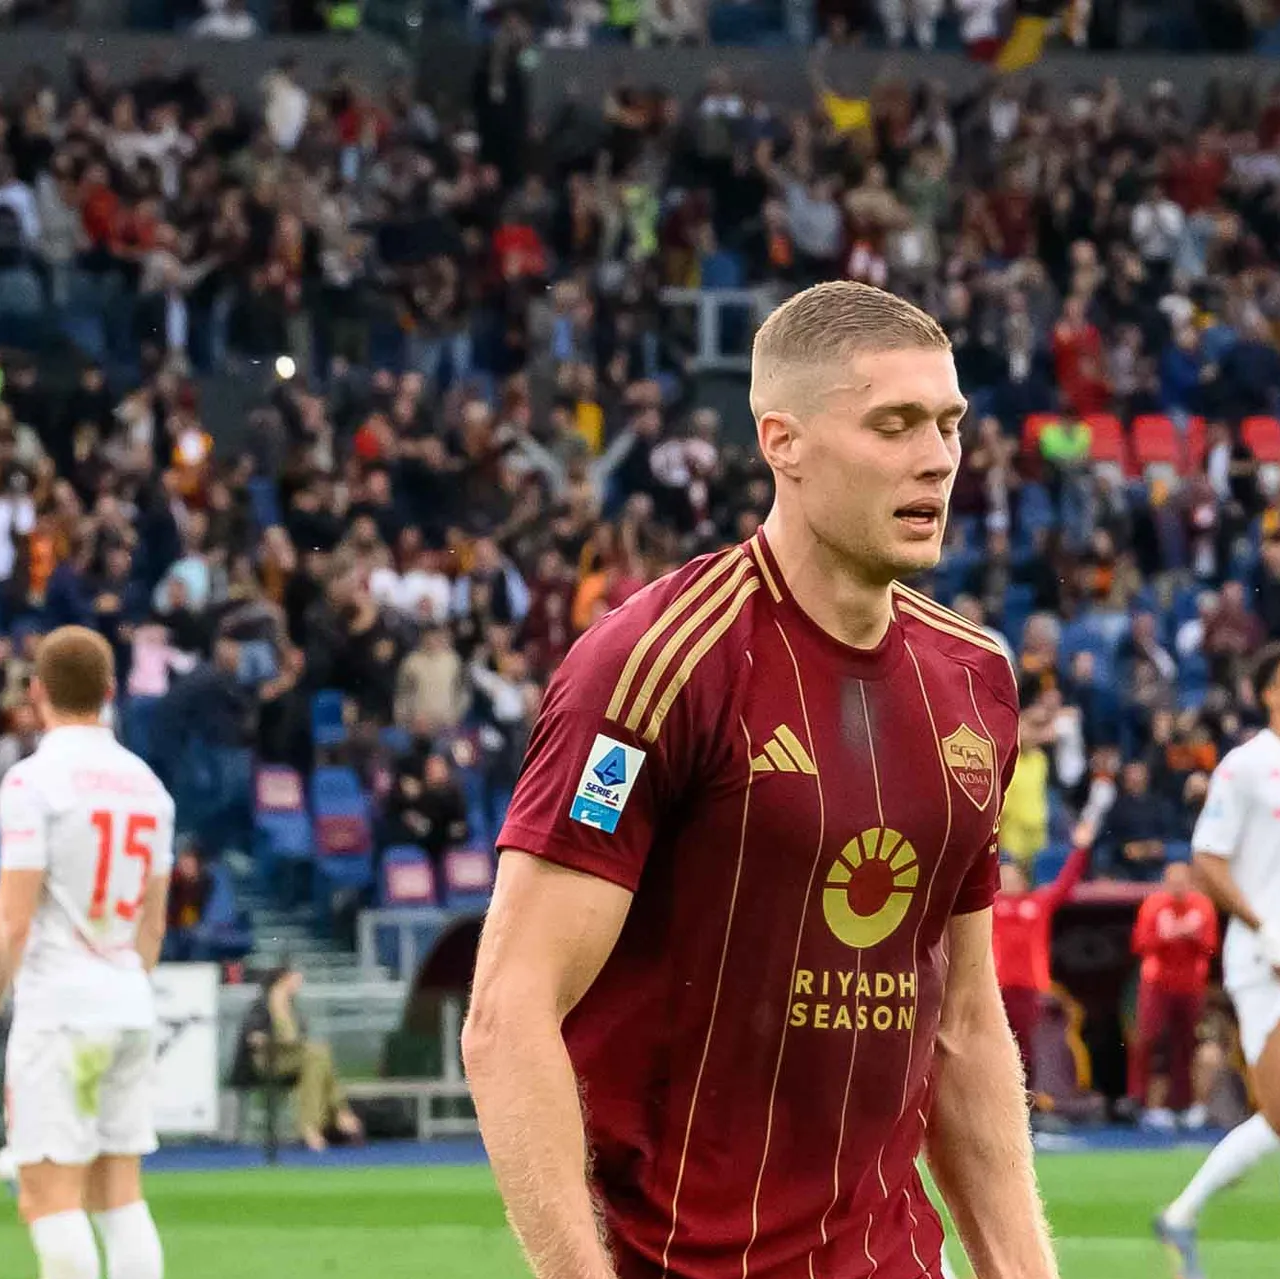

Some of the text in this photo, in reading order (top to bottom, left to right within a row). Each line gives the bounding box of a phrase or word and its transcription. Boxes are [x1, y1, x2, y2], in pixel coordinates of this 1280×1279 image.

[585, 782, 619, 802] SERIE A
[959, 772, 989, 785] ROMA
[87, 808, 157, 922] 15
[794, 969, 915, 998] RIYADH
[789, 1002, 915, 1031] SEASON
